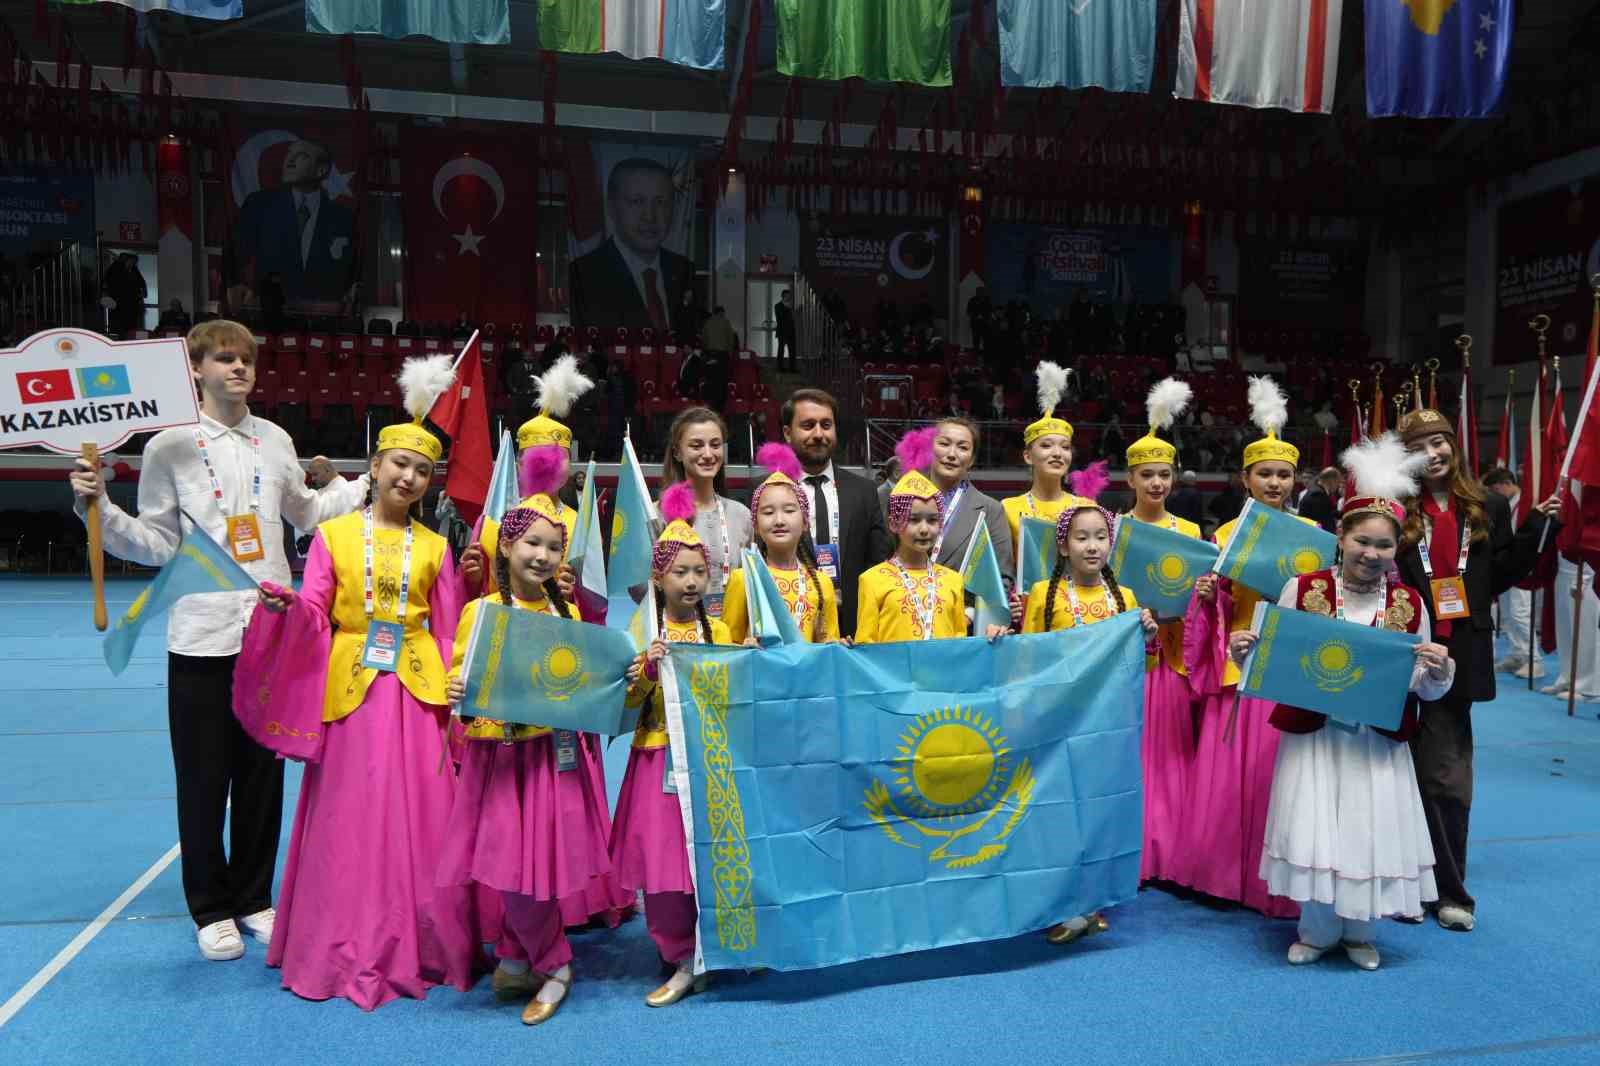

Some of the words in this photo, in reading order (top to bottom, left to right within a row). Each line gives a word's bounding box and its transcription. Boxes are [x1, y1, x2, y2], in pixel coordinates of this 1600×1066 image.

[817, 237, 834, 251] 23
[839, 235, 886, 254] NİSAN
[1499, 266, 1520, 287] 23
[1524, 251, 1583, 284] NİSAN
[1, 400, 158, 433] KAZAKİSTAN
